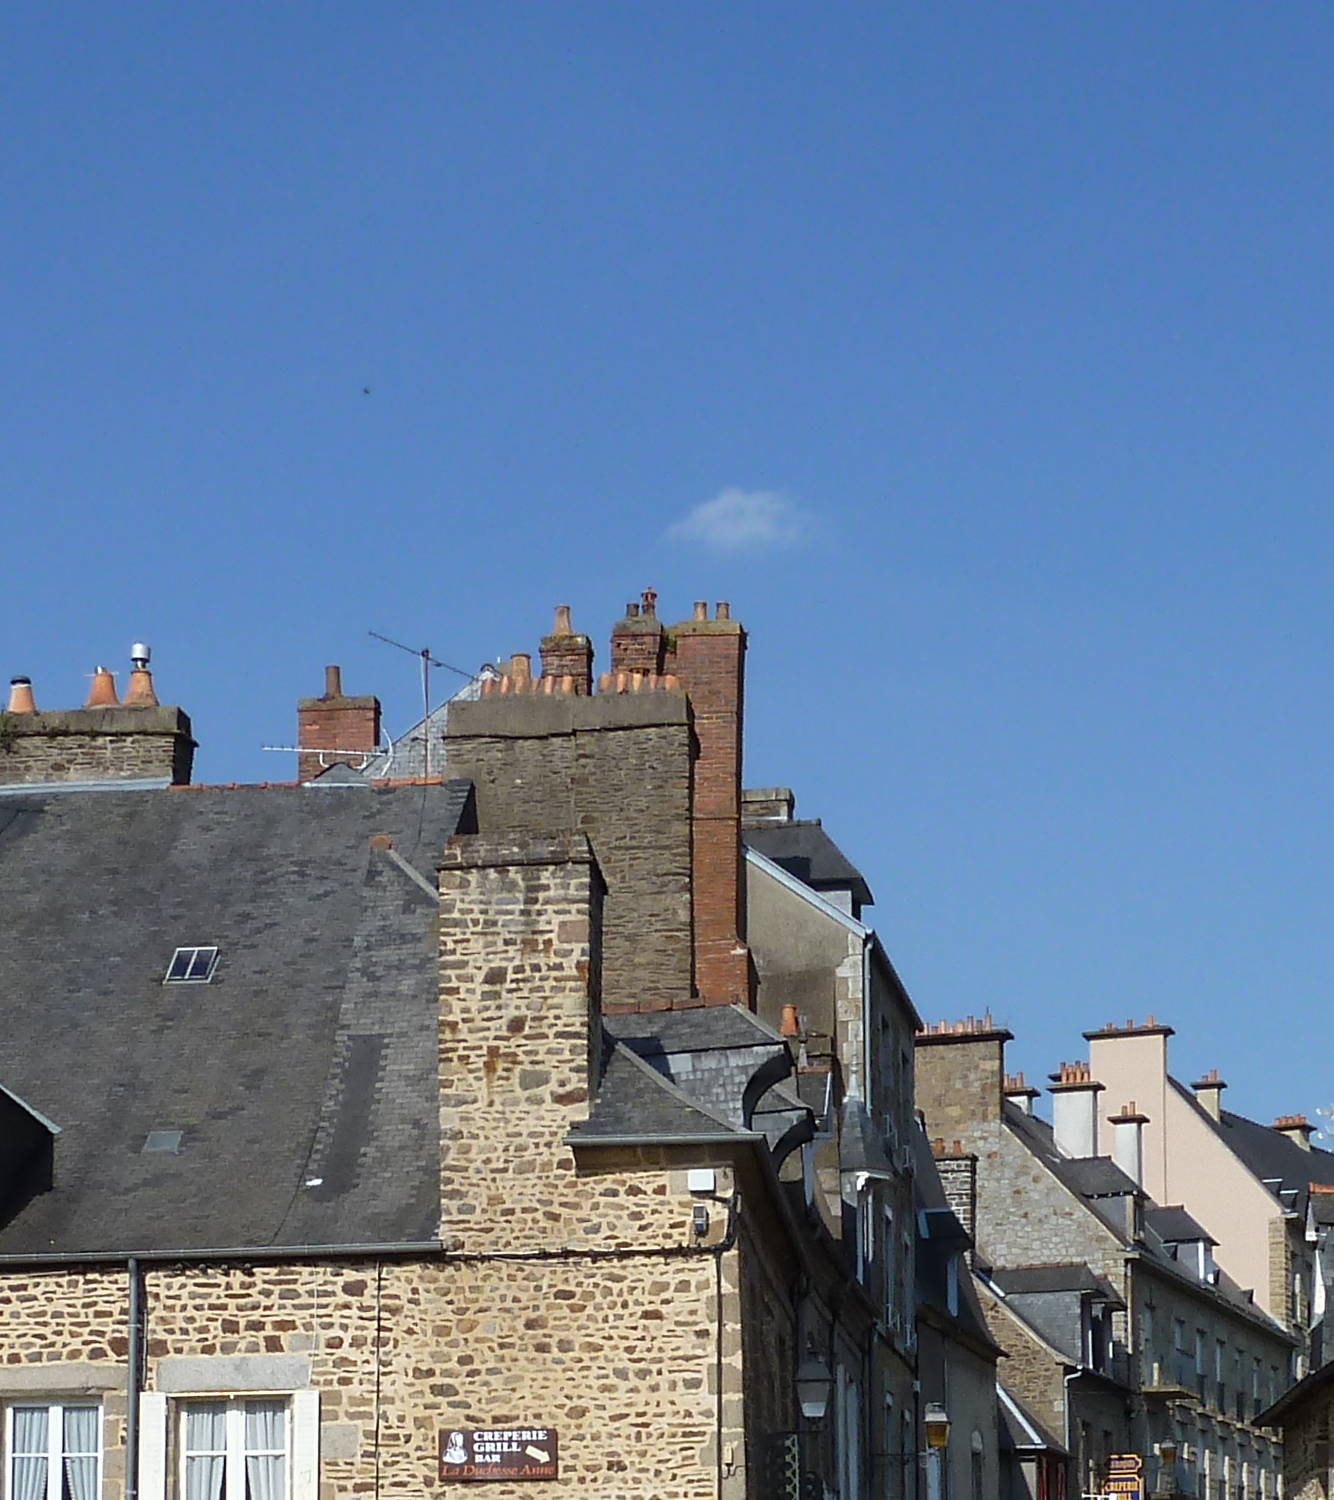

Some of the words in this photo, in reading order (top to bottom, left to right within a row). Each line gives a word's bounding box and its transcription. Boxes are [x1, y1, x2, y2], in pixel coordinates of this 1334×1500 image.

[473, 1430, 548, 1441] CREPERIE
[473, 1442, 522, 1452] GRILL
[474, 1454, 501, 1463] BAR
[442, 1465, 460, 1476] La
[463, 1462, 518, 1476] Duchesse
[520, 1464, 555, 1475] Anne
